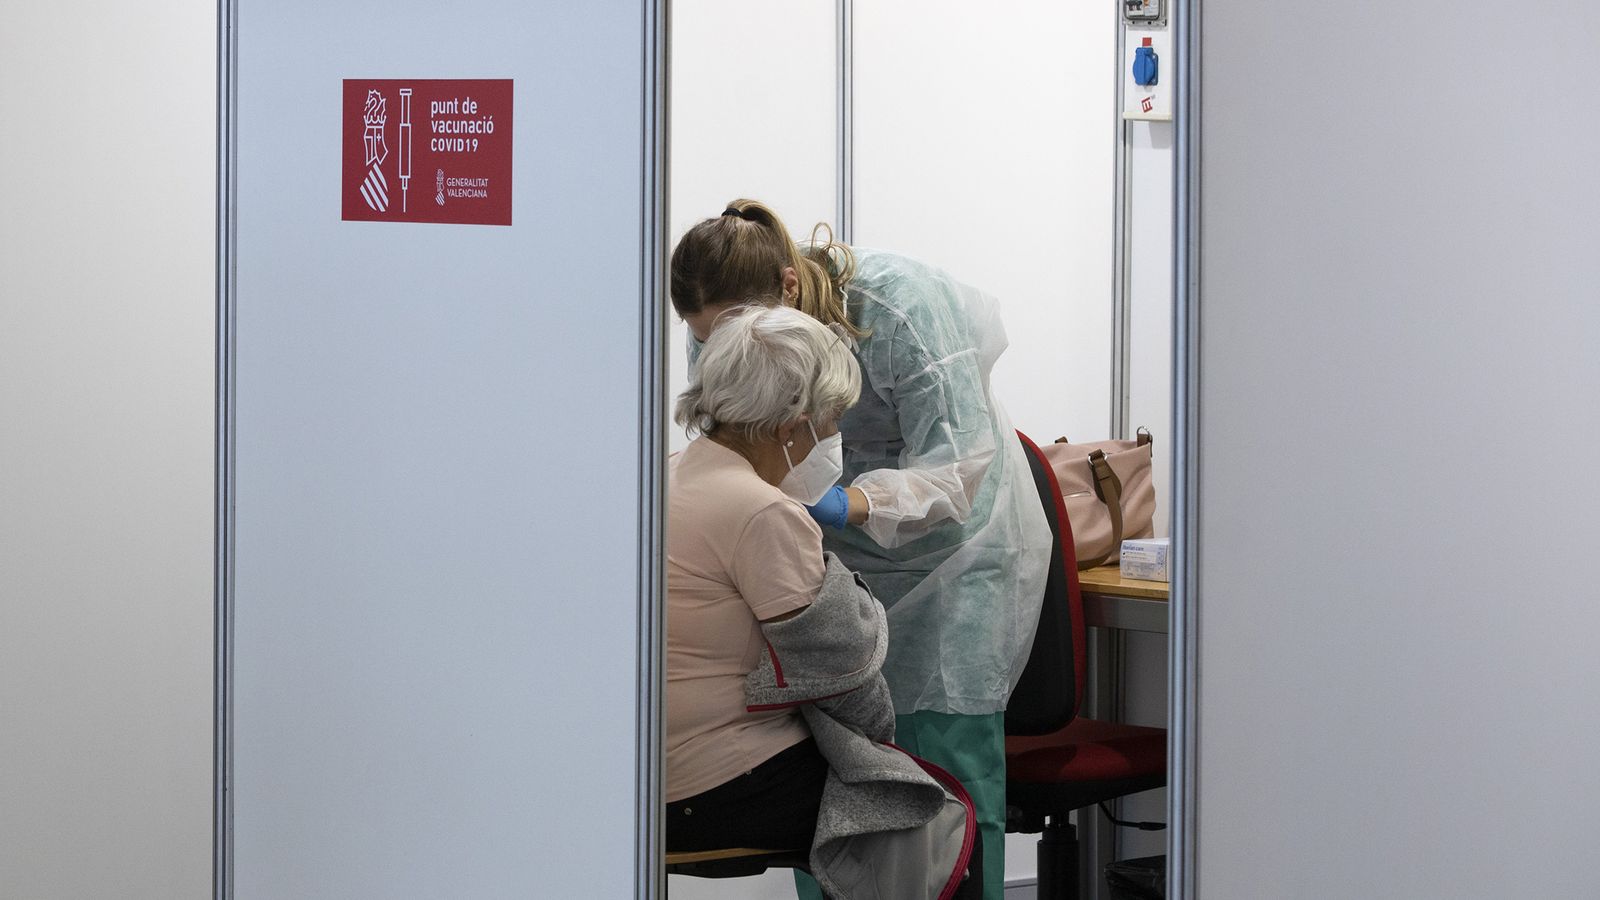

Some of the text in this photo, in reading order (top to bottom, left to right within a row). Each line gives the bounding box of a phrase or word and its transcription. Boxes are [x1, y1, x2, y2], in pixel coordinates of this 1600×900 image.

[431, 97, 477, 118] punt de
[431, 115, 494, 134] vacunació
[431, 138, 478, 152] COVID19
[446, 178, 488, 187] GENERALITAT
[447, 189, 487, 198] VALENCIANA
